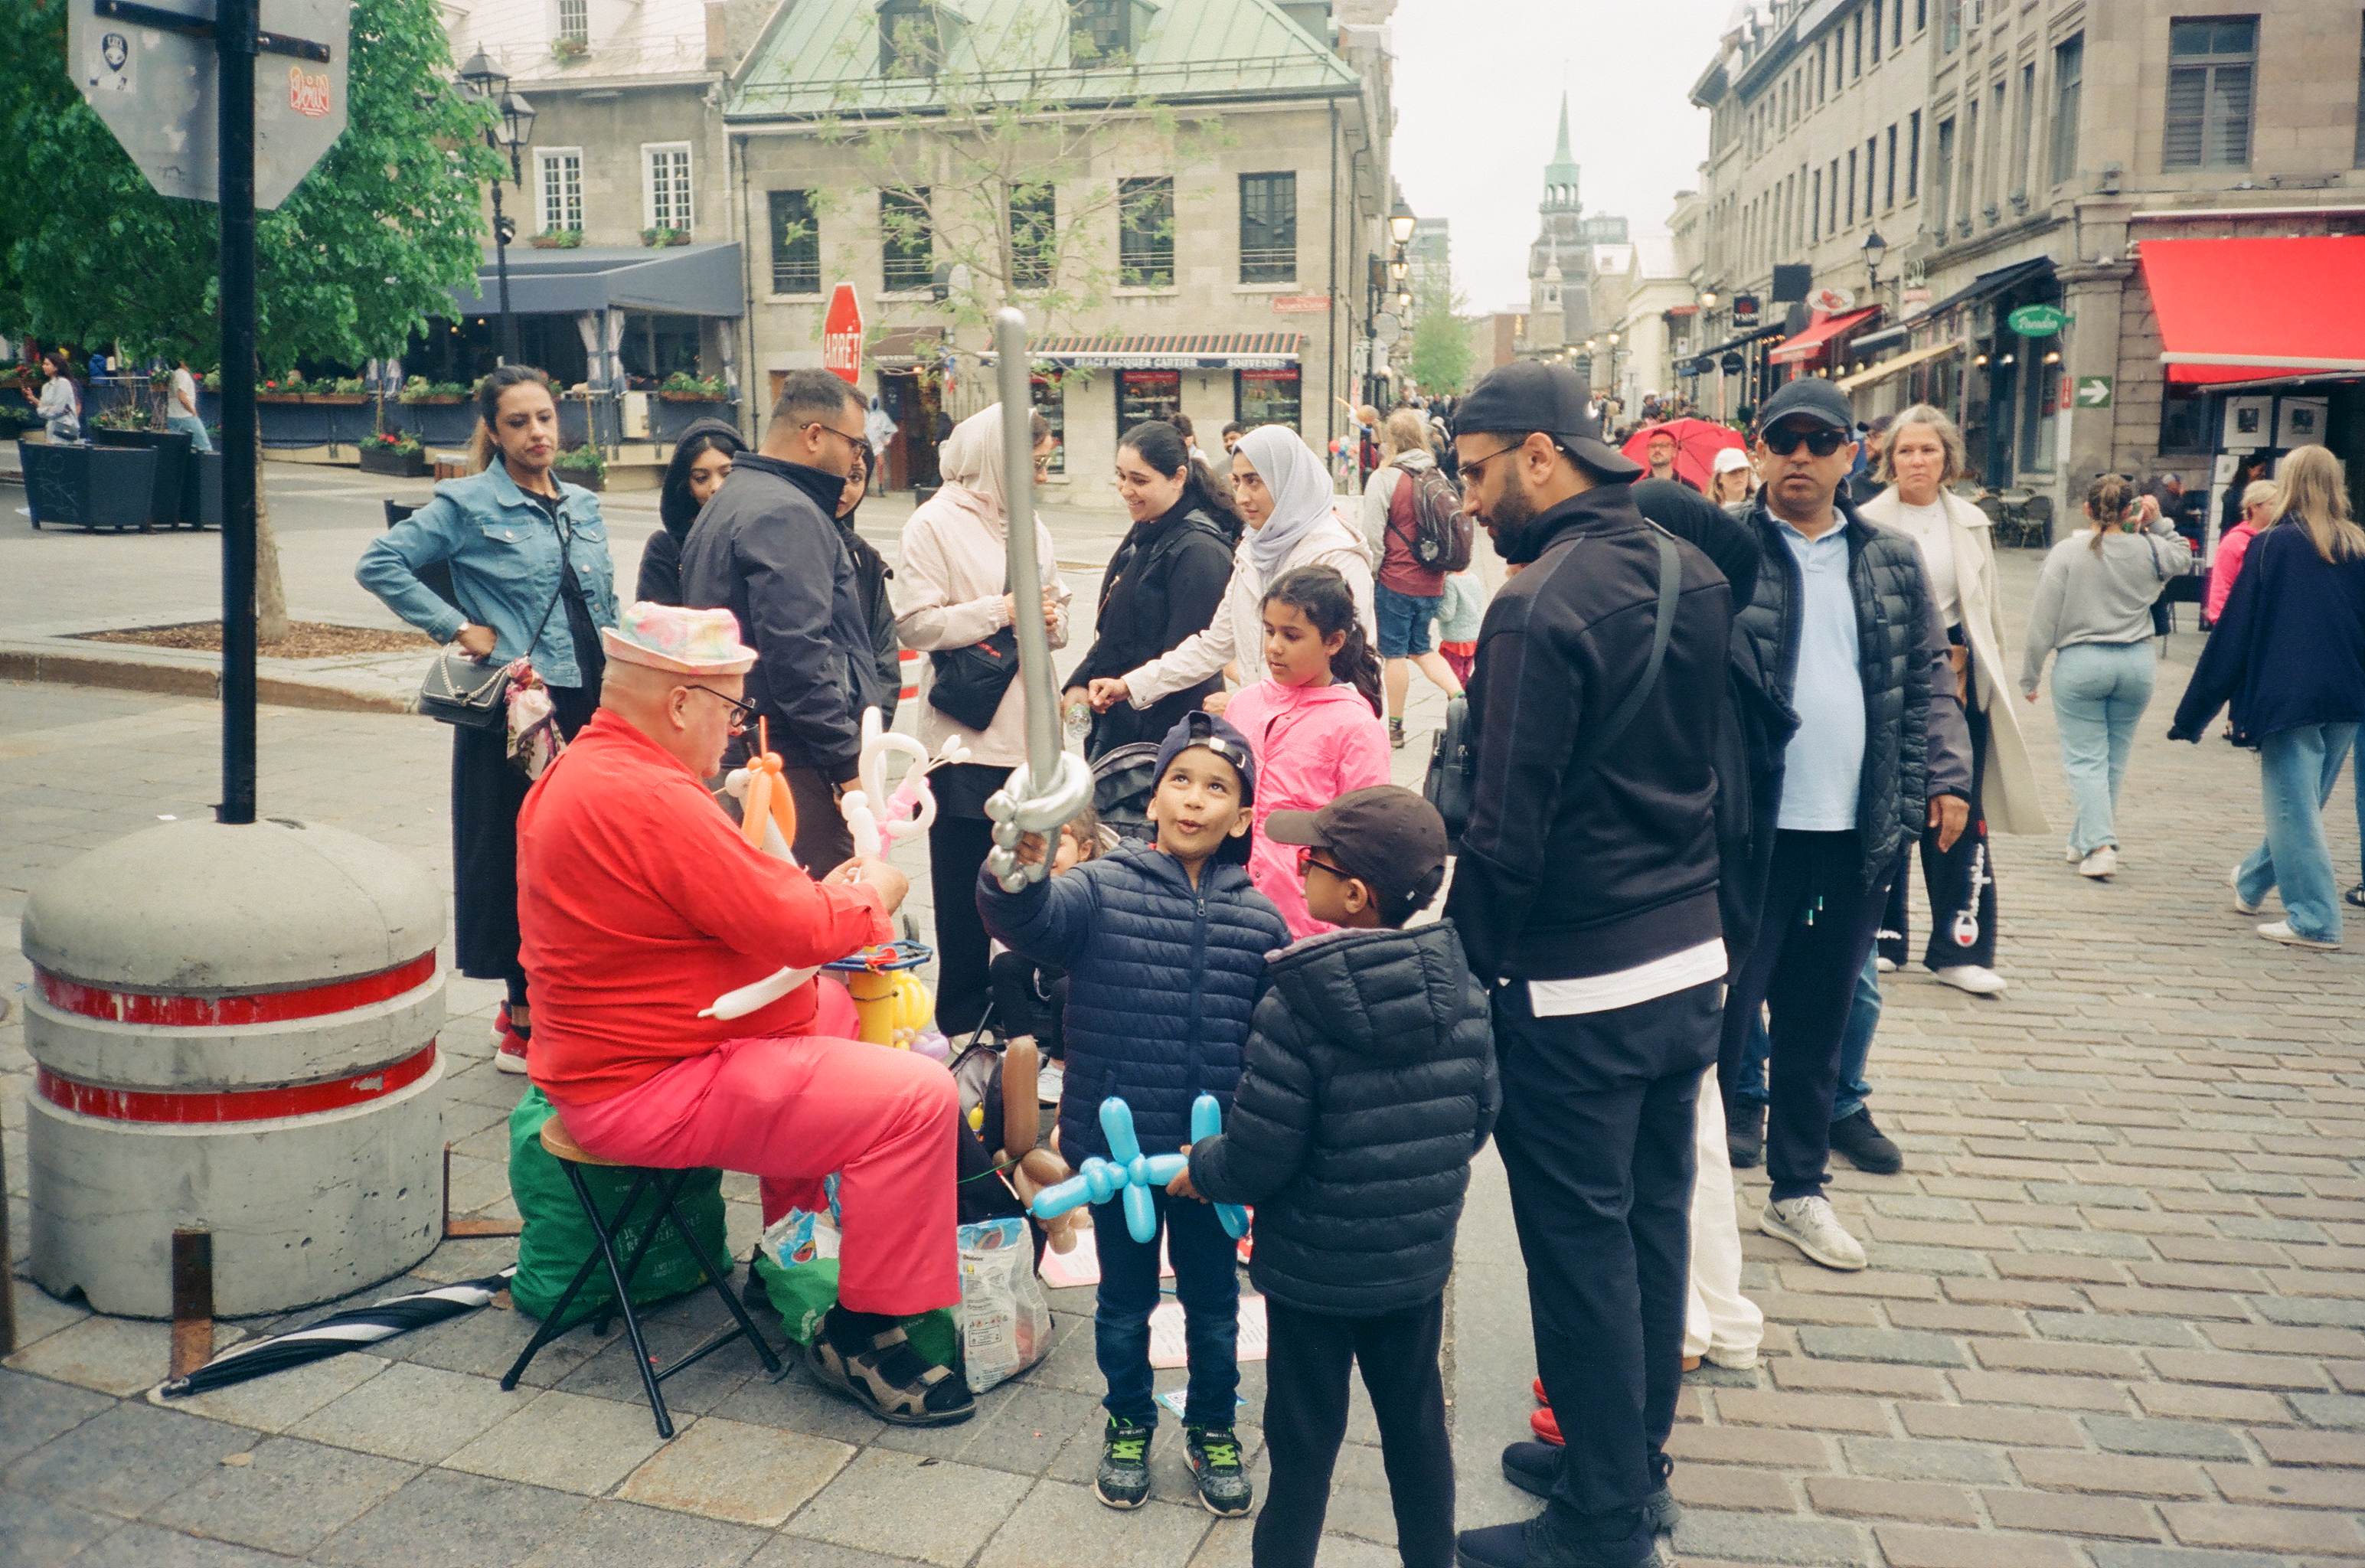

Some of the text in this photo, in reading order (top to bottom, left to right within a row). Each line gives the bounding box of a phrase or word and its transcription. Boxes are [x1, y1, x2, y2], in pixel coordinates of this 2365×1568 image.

[824, 325, 860, 369] ARRÊT
[1074, 358, 1198, 368] PLACE JACQUES CARTIER
[1227, 358, 1286, 368] SOUVENIRS
[1954, 843, 1991, 948] Champion
